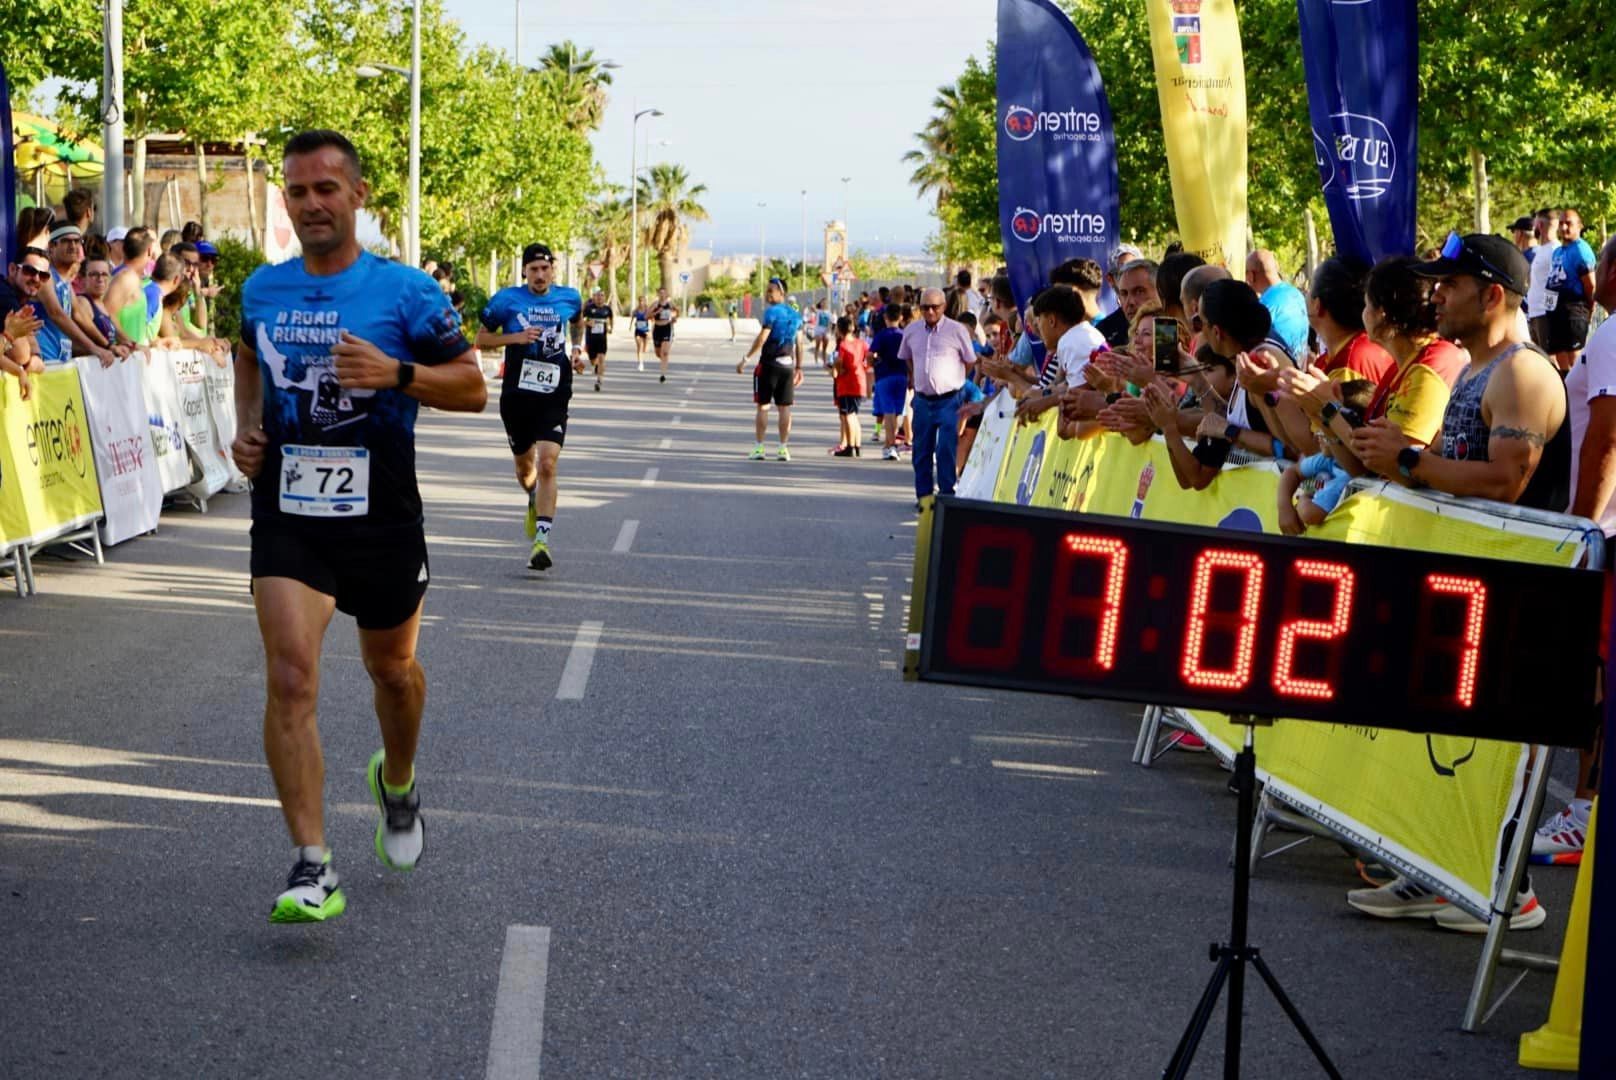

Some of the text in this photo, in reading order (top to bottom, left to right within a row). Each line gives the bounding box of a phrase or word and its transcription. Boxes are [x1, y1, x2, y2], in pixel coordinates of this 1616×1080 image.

[291, 310, 339, 326] ROAD
[536, 370, 553, 385] 64
[315, 467, 354, 494] 72
